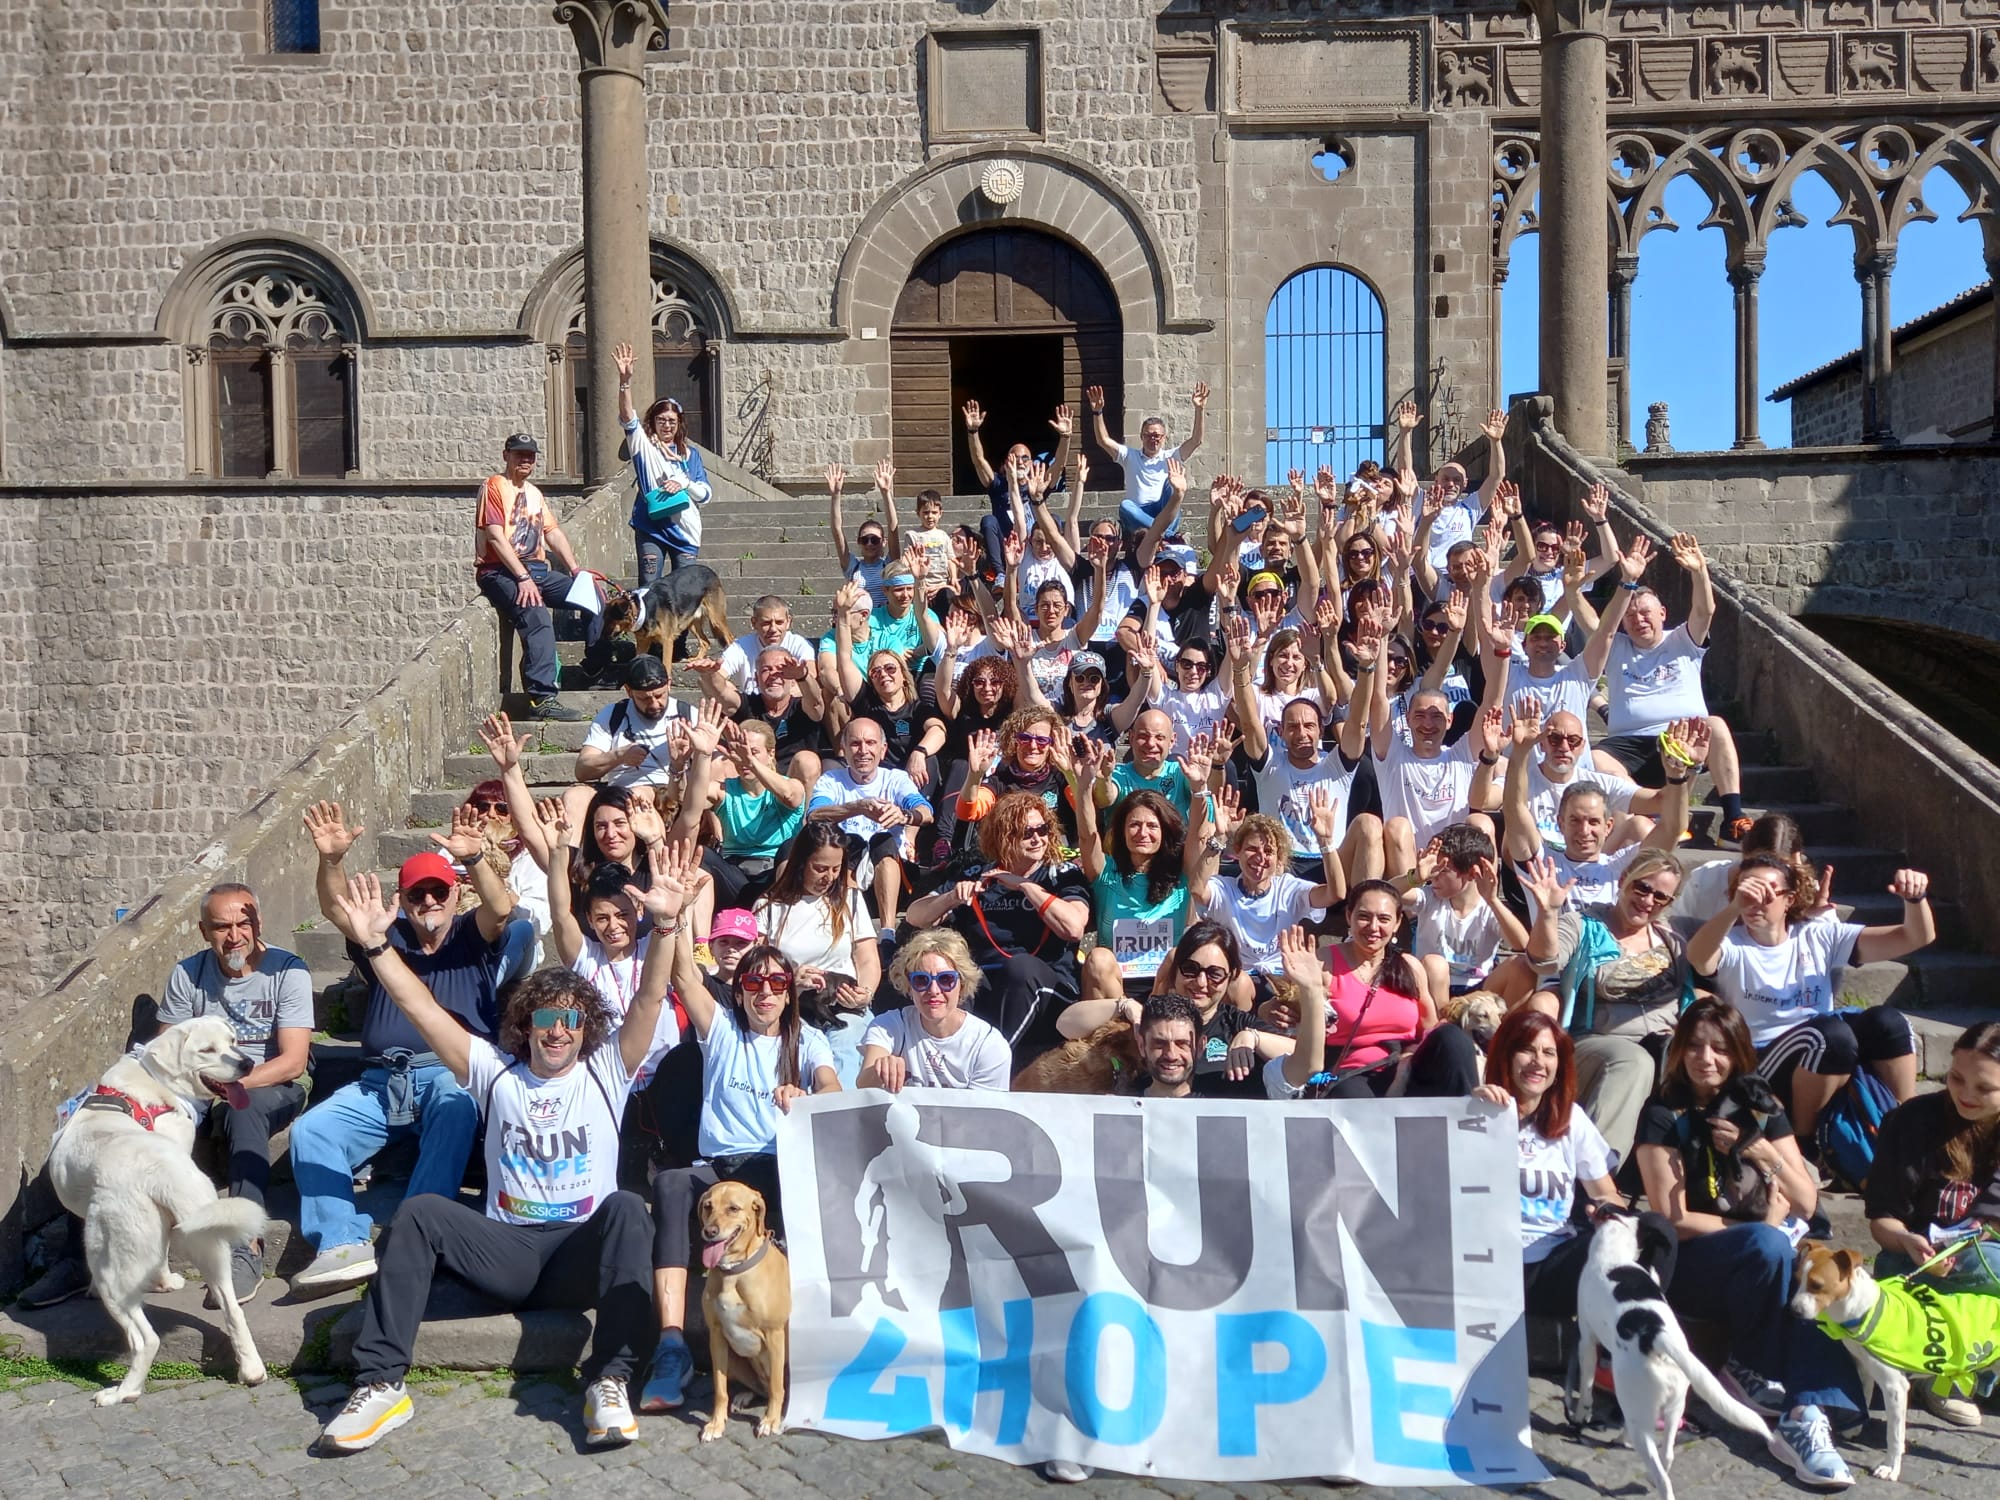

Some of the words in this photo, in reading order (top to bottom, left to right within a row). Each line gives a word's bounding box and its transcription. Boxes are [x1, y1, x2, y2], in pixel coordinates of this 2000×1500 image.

[1116, 935, 1168, 953] RUN
[501, 1120, 588, 1163] RUN
[510, 1201, 578, 1218] MASSIGEN
[811, 1103, 1457, 1331] RUN
[1457, 1114, 1518, 1474] ITALIA
[823, 1291, 1475, 1473] 4HOPE
